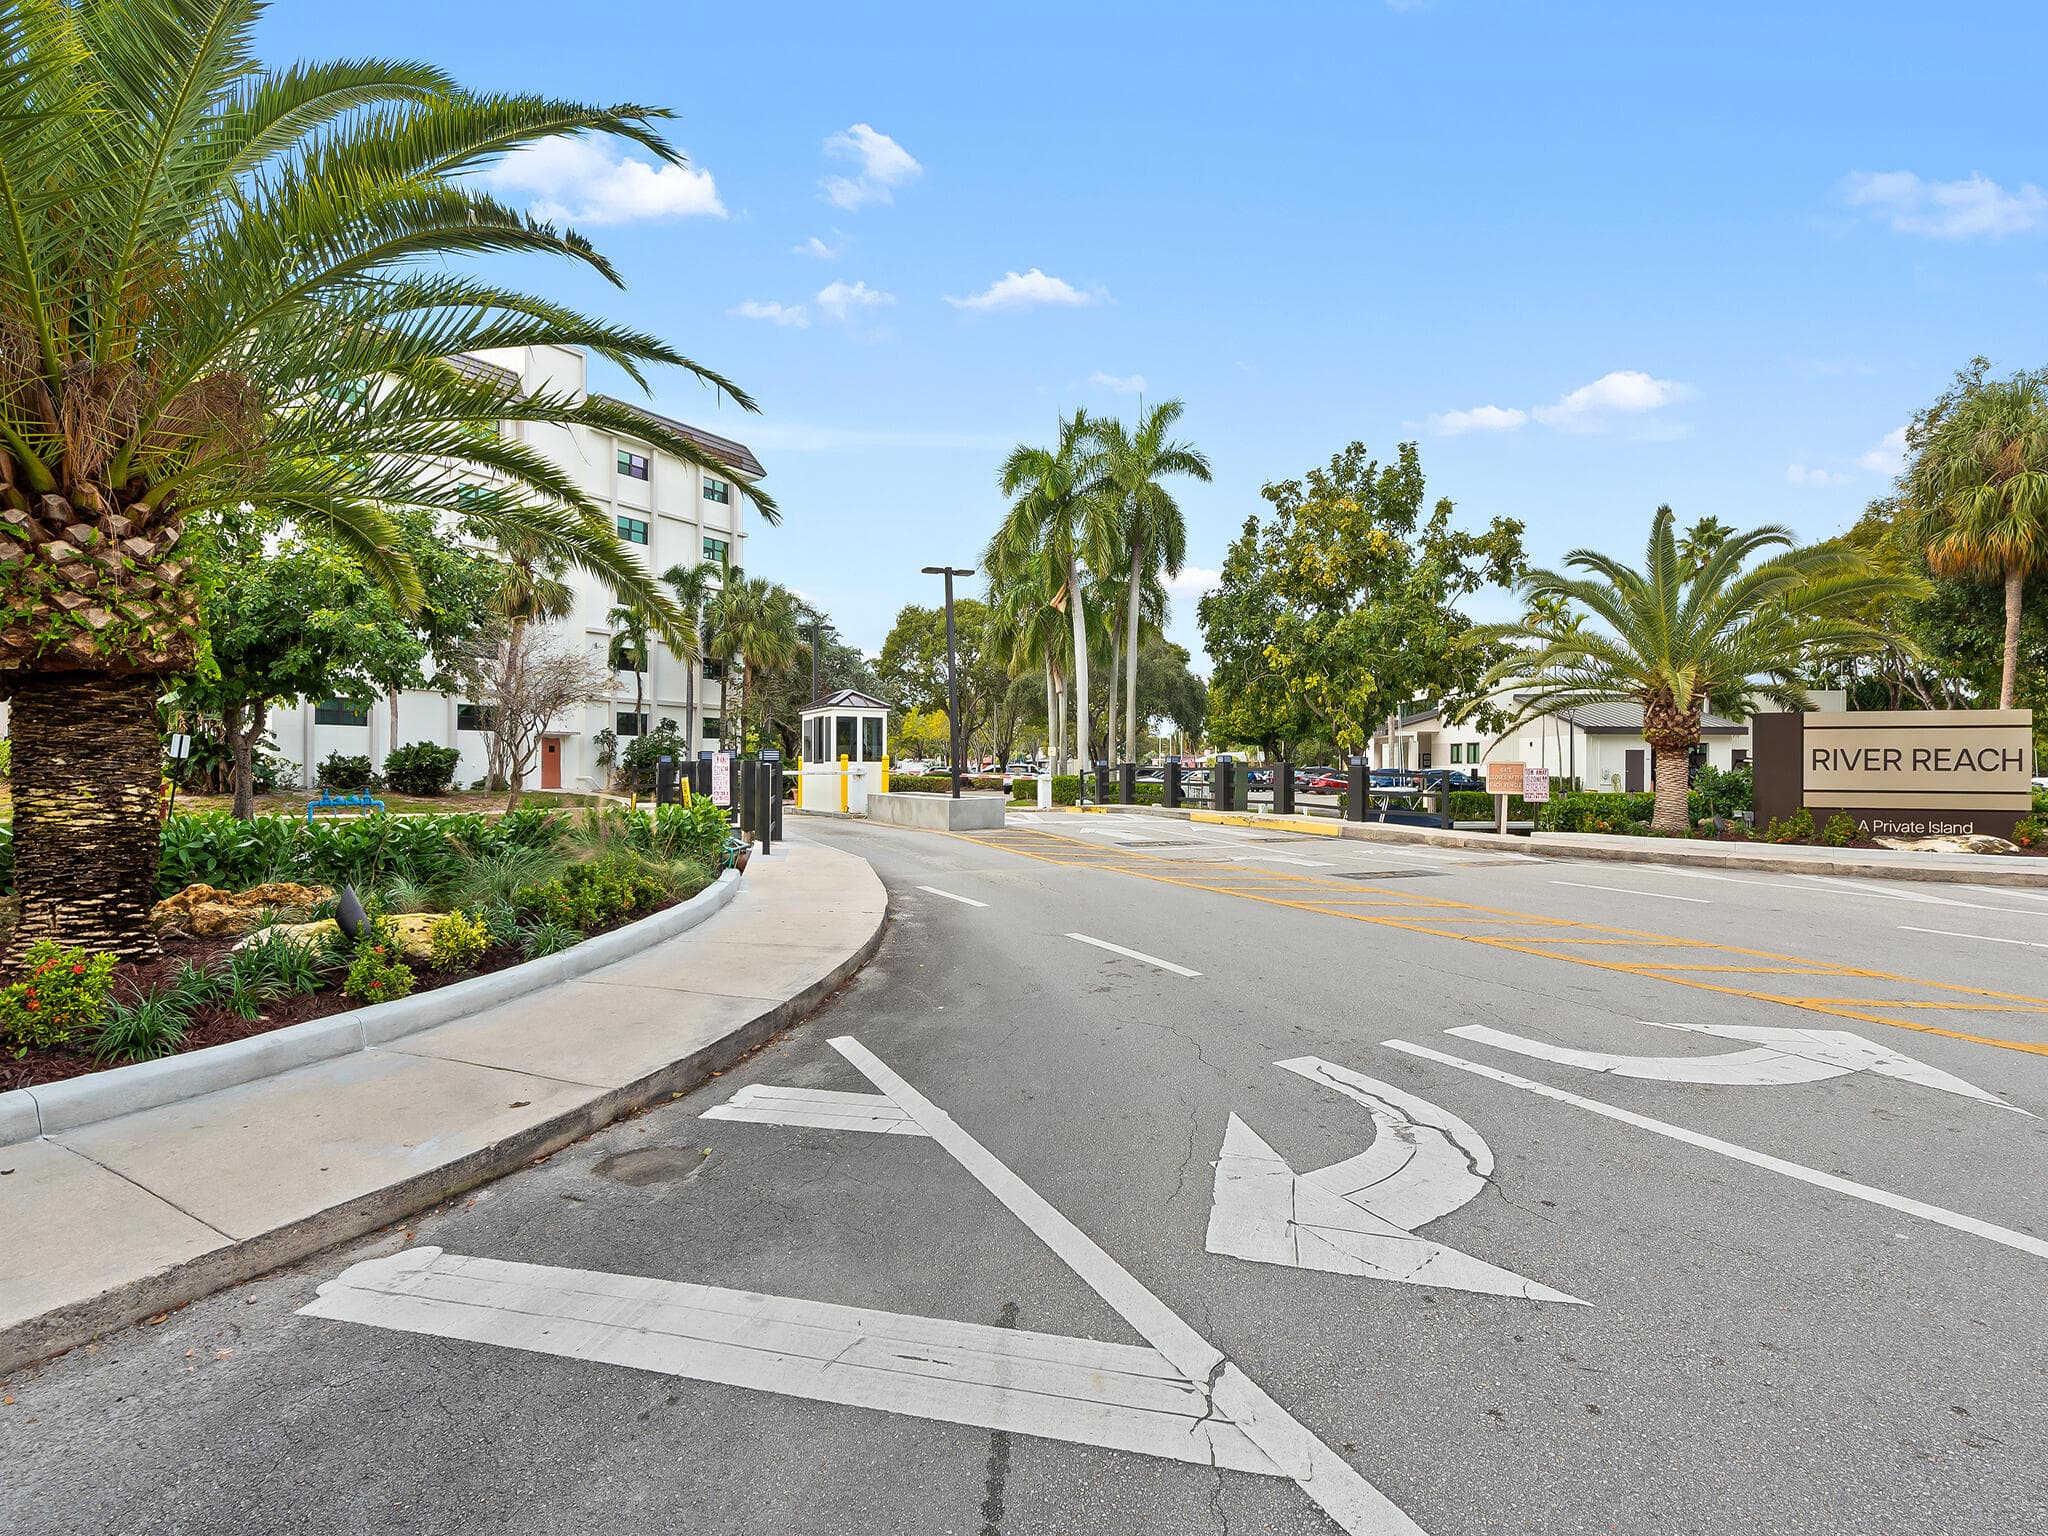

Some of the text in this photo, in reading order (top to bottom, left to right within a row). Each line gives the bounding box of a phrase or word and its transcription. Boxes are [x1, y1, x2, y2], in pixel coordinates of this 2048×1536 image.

[1812, 748, 2024, 772] RIVER REACH
[1858, 819, 1974, 834] A Private Island
